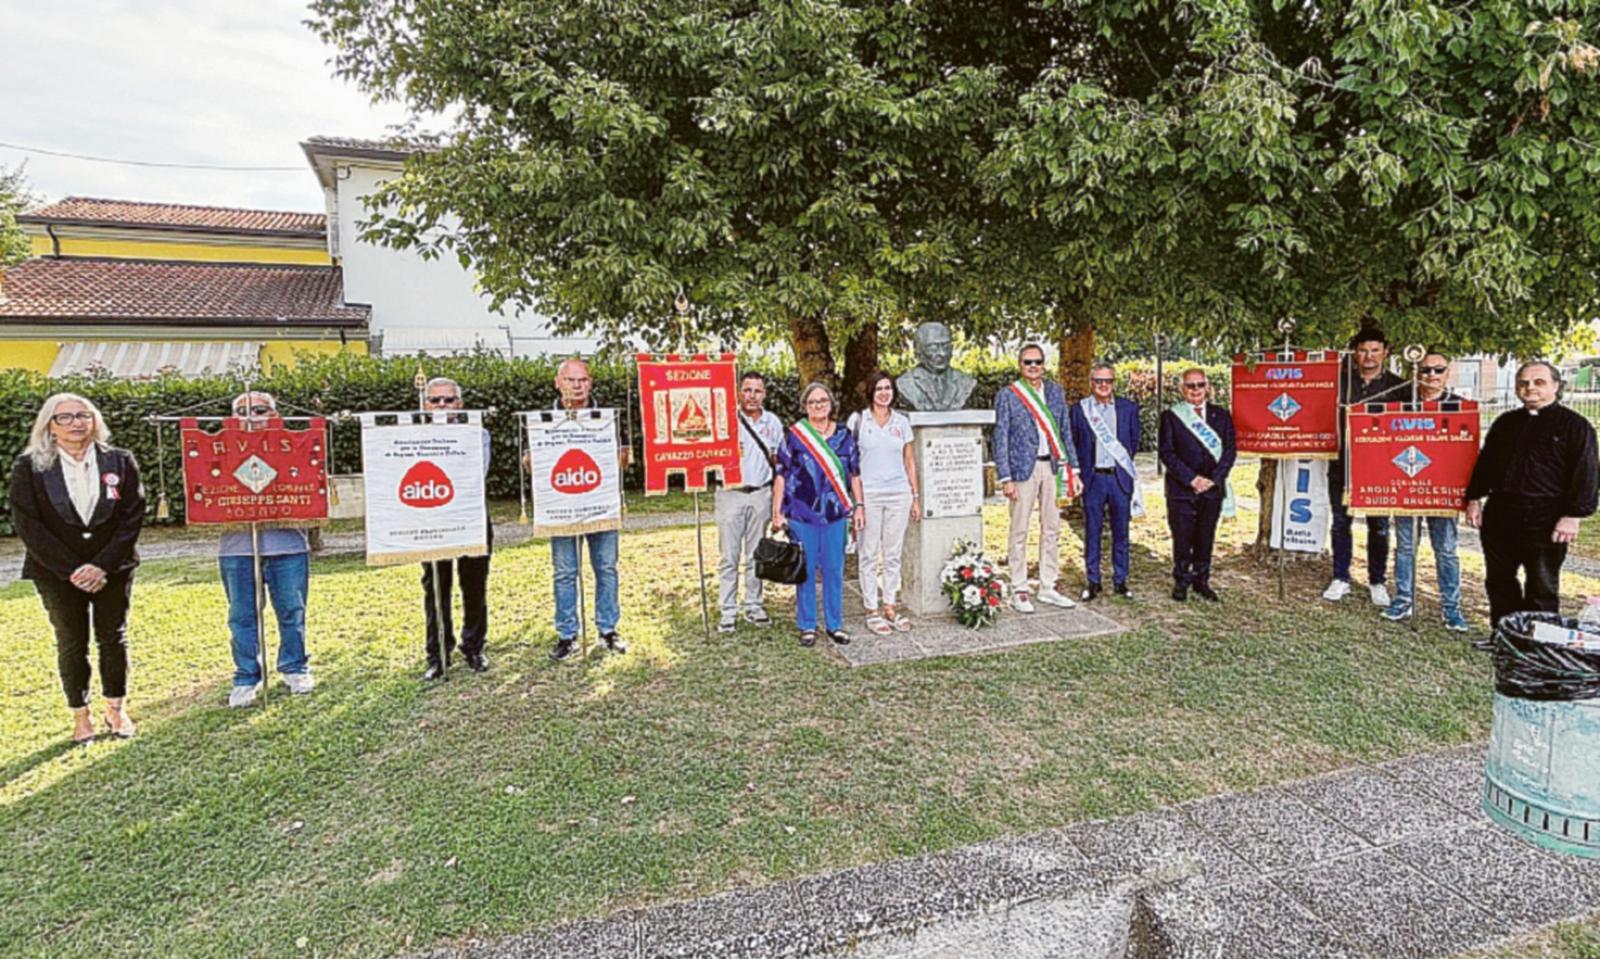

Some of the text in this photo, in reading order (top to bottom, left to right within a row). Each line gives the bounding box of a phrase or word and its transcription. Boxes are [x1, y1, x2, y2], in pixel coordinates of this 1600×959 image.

[665, 369, 712, 381] SEZIONE
[1265, 368, 1304, 380] AVIS
[1391, 418, 1436, 430] AVIS
[1192, 420, 1218, 449] AVIS
[555, 466, 598, 487] aido
[402, 480, 450, 500] aido
[276, 495, 311, 505] SANTI
